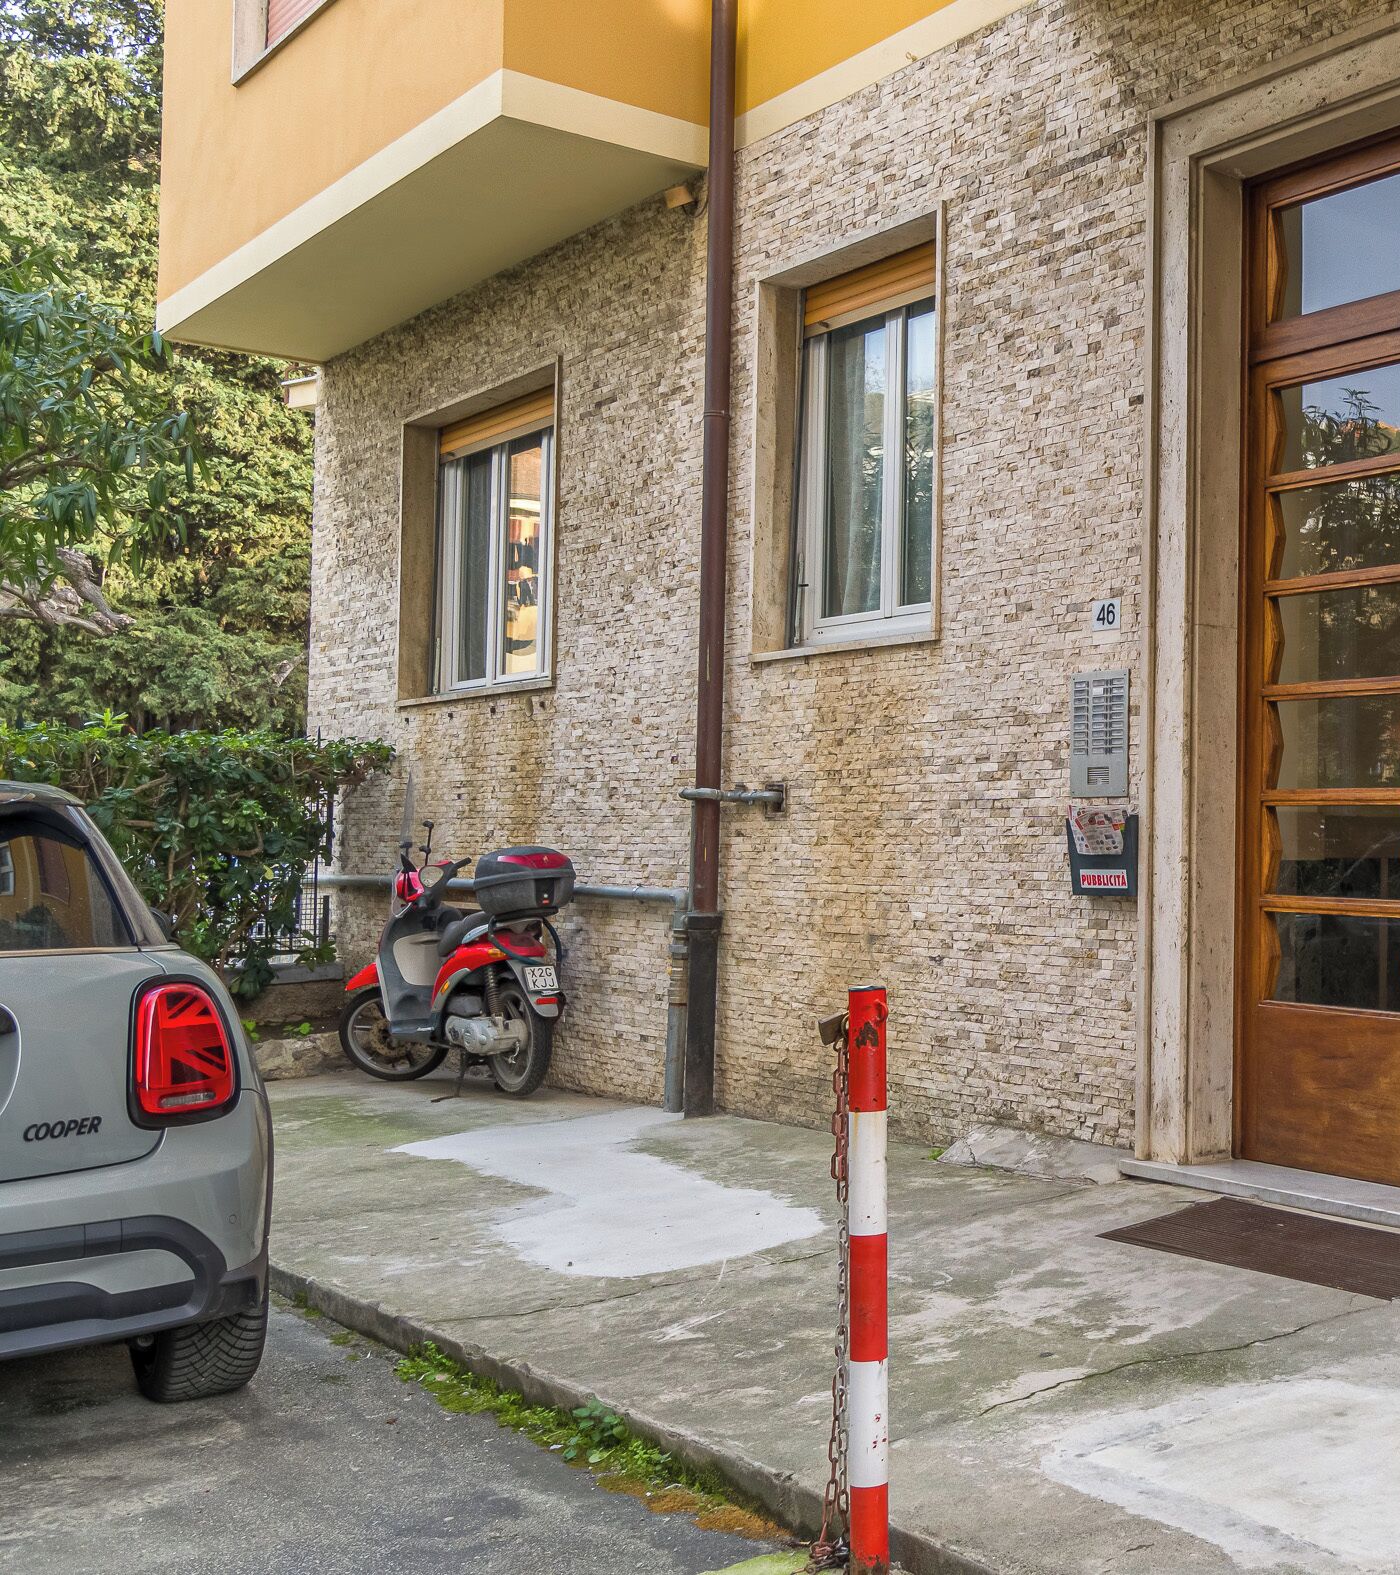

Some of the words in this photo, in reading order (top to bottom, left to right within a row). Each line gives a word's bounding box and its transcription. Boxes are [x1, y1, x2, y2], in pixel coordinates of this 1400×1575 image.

[1096, 603, 1115, 625] 46
[1081, 872, 1127, 887] PUBBLICITÀ
[530, 967, 552, 978] X2G
[532, 978, 555, 989] KJJ
[22, 1115, 103, 1143] COOPER
